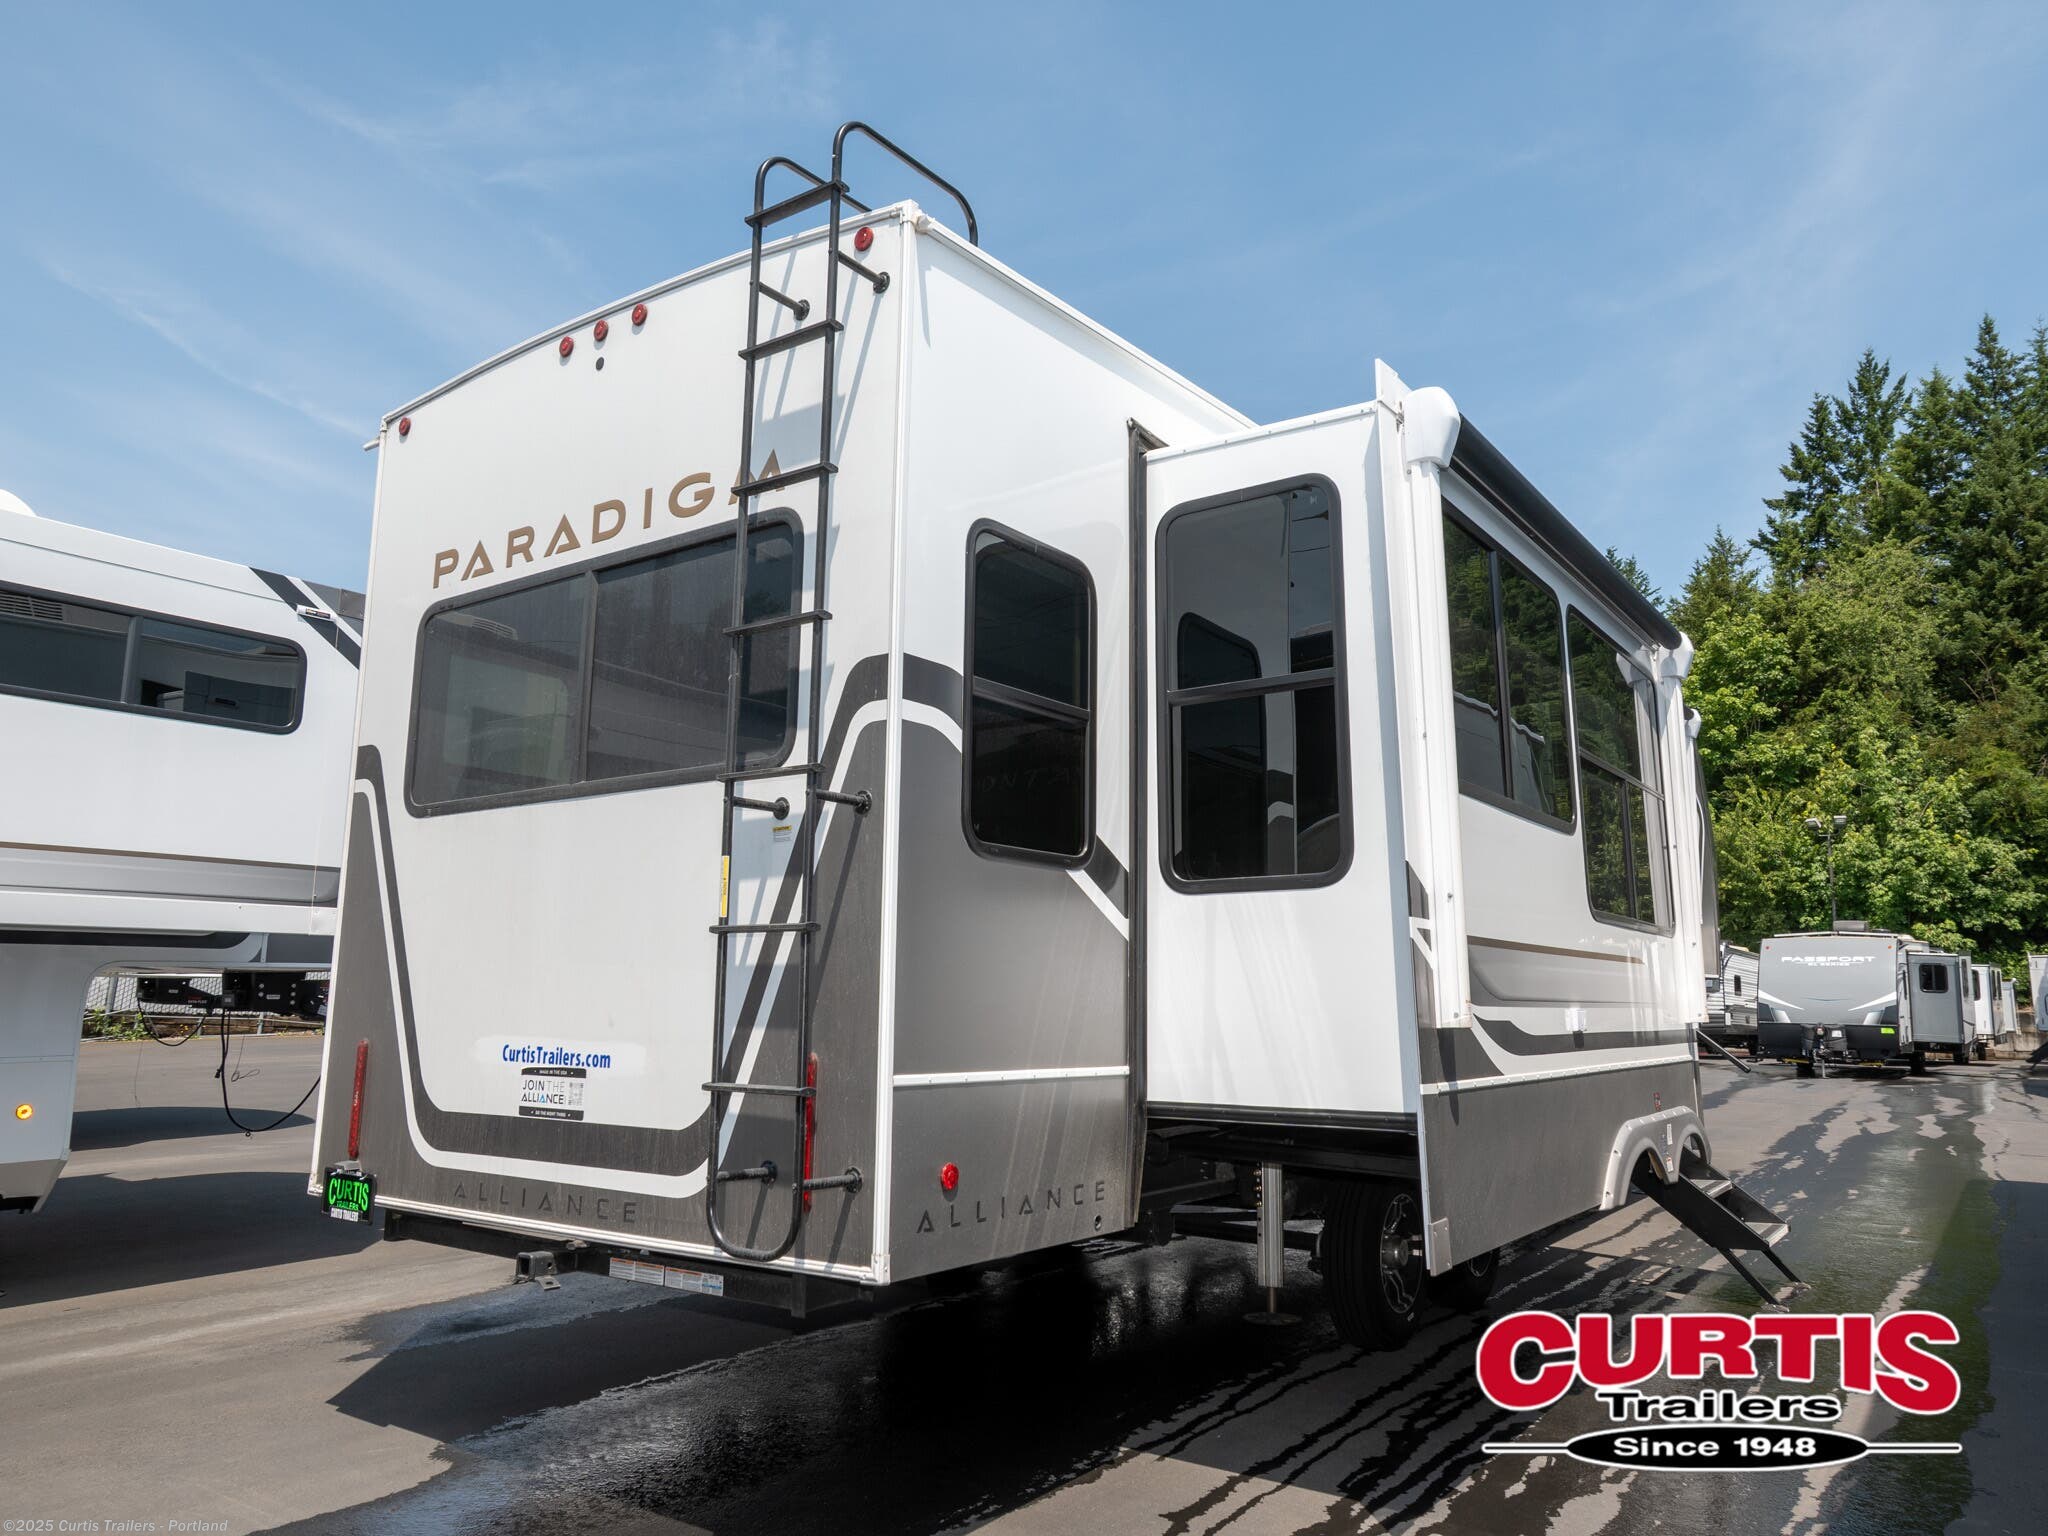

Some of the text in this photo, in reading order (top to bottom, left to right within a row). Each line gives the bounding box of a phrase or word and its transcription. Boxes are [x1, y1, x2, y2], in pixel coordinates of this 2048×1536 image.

[502, 1044, 611, 1069] CurtisTrailers.com
[521, 1092, 564, 1104] ALLIANCE
[522, 1079, 565, 1093] JOIN THE
[328, 1178, 369, 1211] CURTIS
[454, 1181, 637, 1224] ALLIANCE
[916, 1179, 1105, 1234] ALLIANCE
